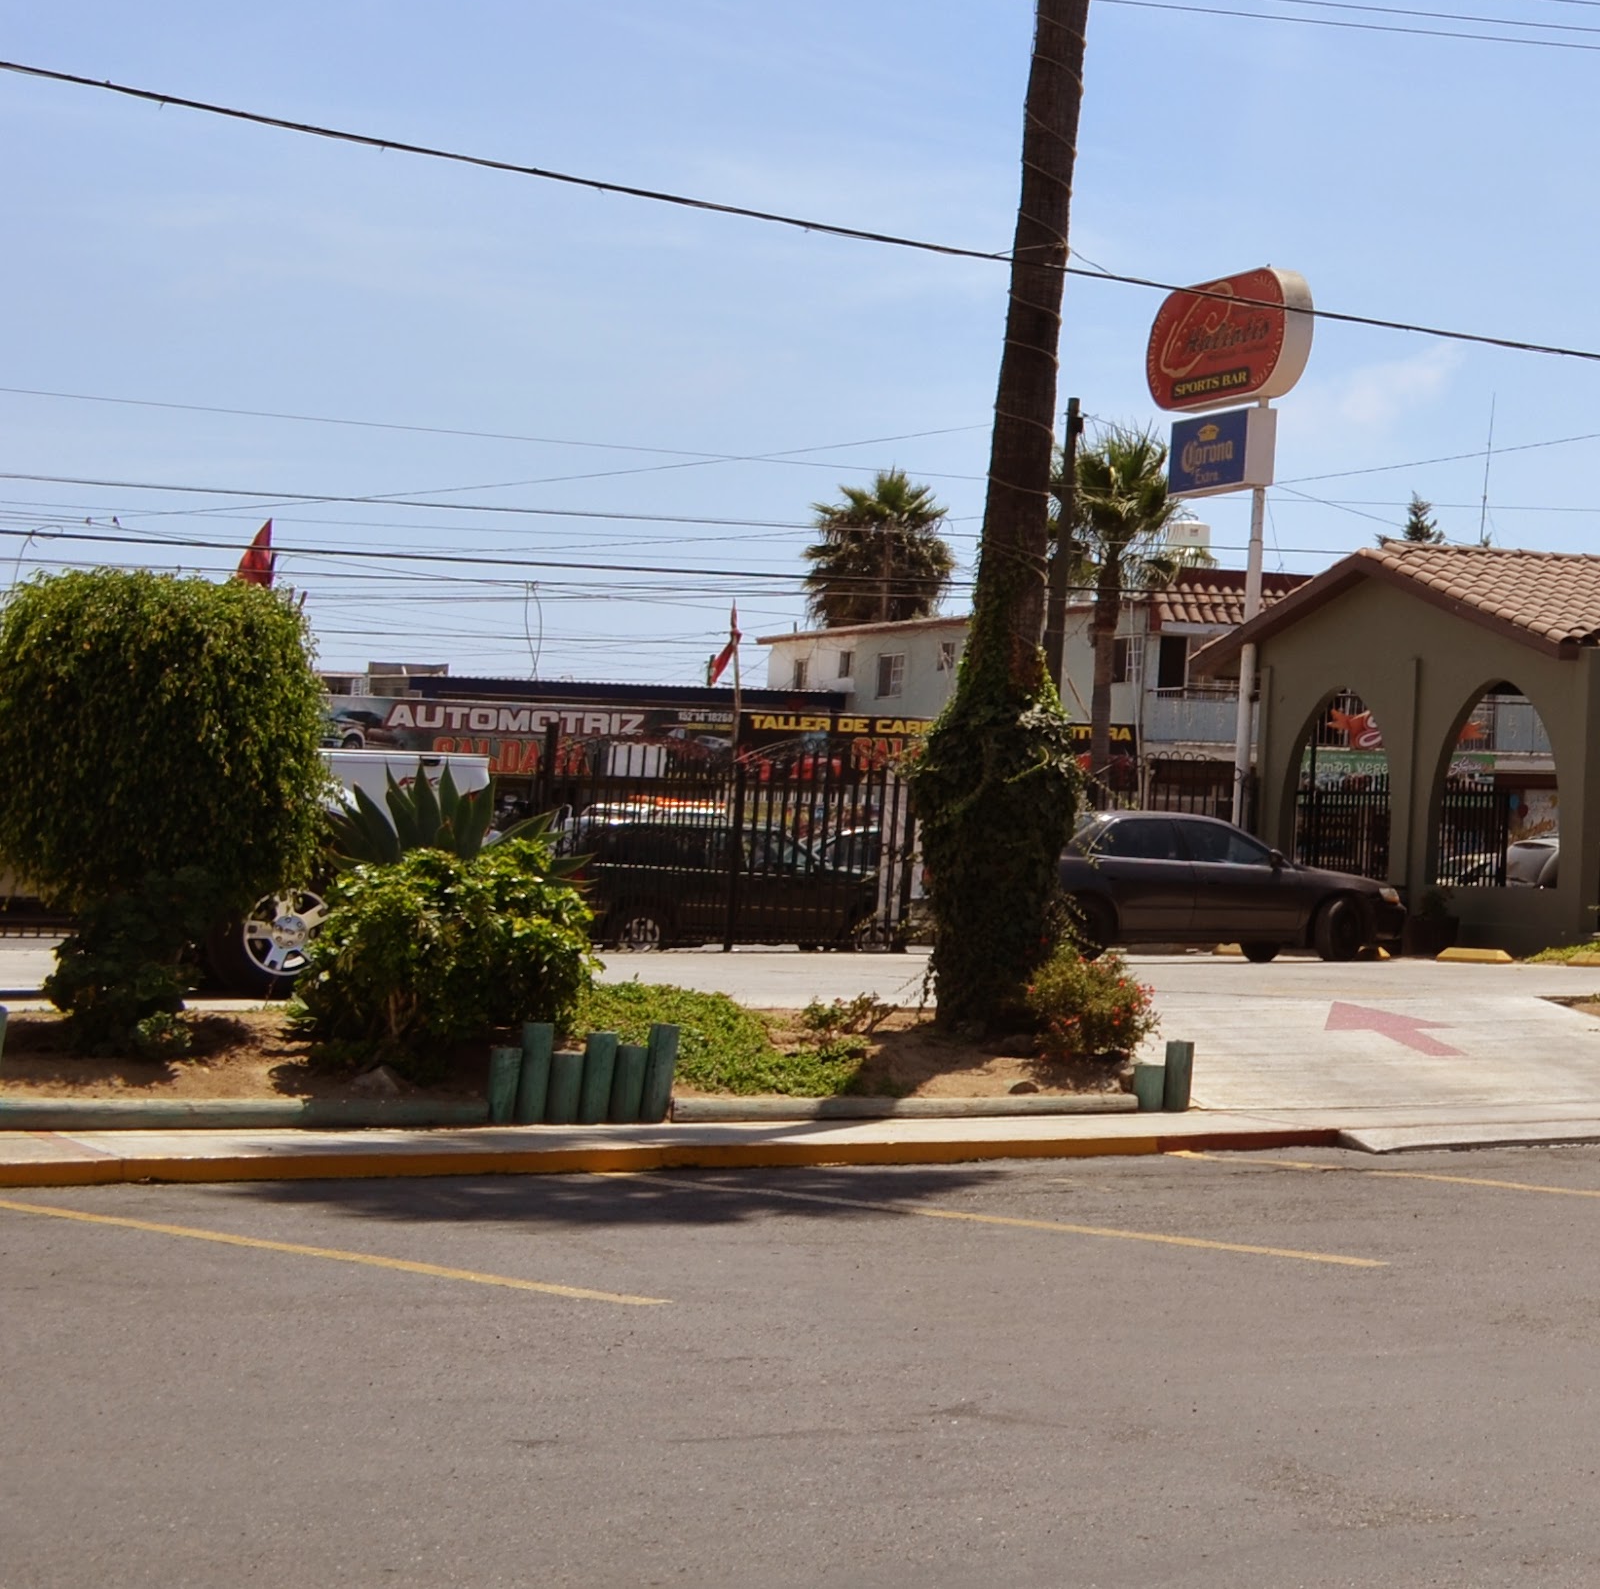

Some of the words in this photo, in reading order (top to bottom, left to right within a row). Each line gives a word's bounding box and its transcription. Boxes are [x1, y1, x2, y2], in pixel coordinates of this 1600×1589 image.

[1174, 376, 1220, 397] SPORTS
[1222, 371, 1248, 387] BAR
[1181, 439, 1233, 475] Corona
[388, 704, 645, 735] AUTOMOTRIZ
[751, 715, 831, 731] TALLER
[838, 718, 870, 733] DE
[876, 719, 936, 735] CARR
